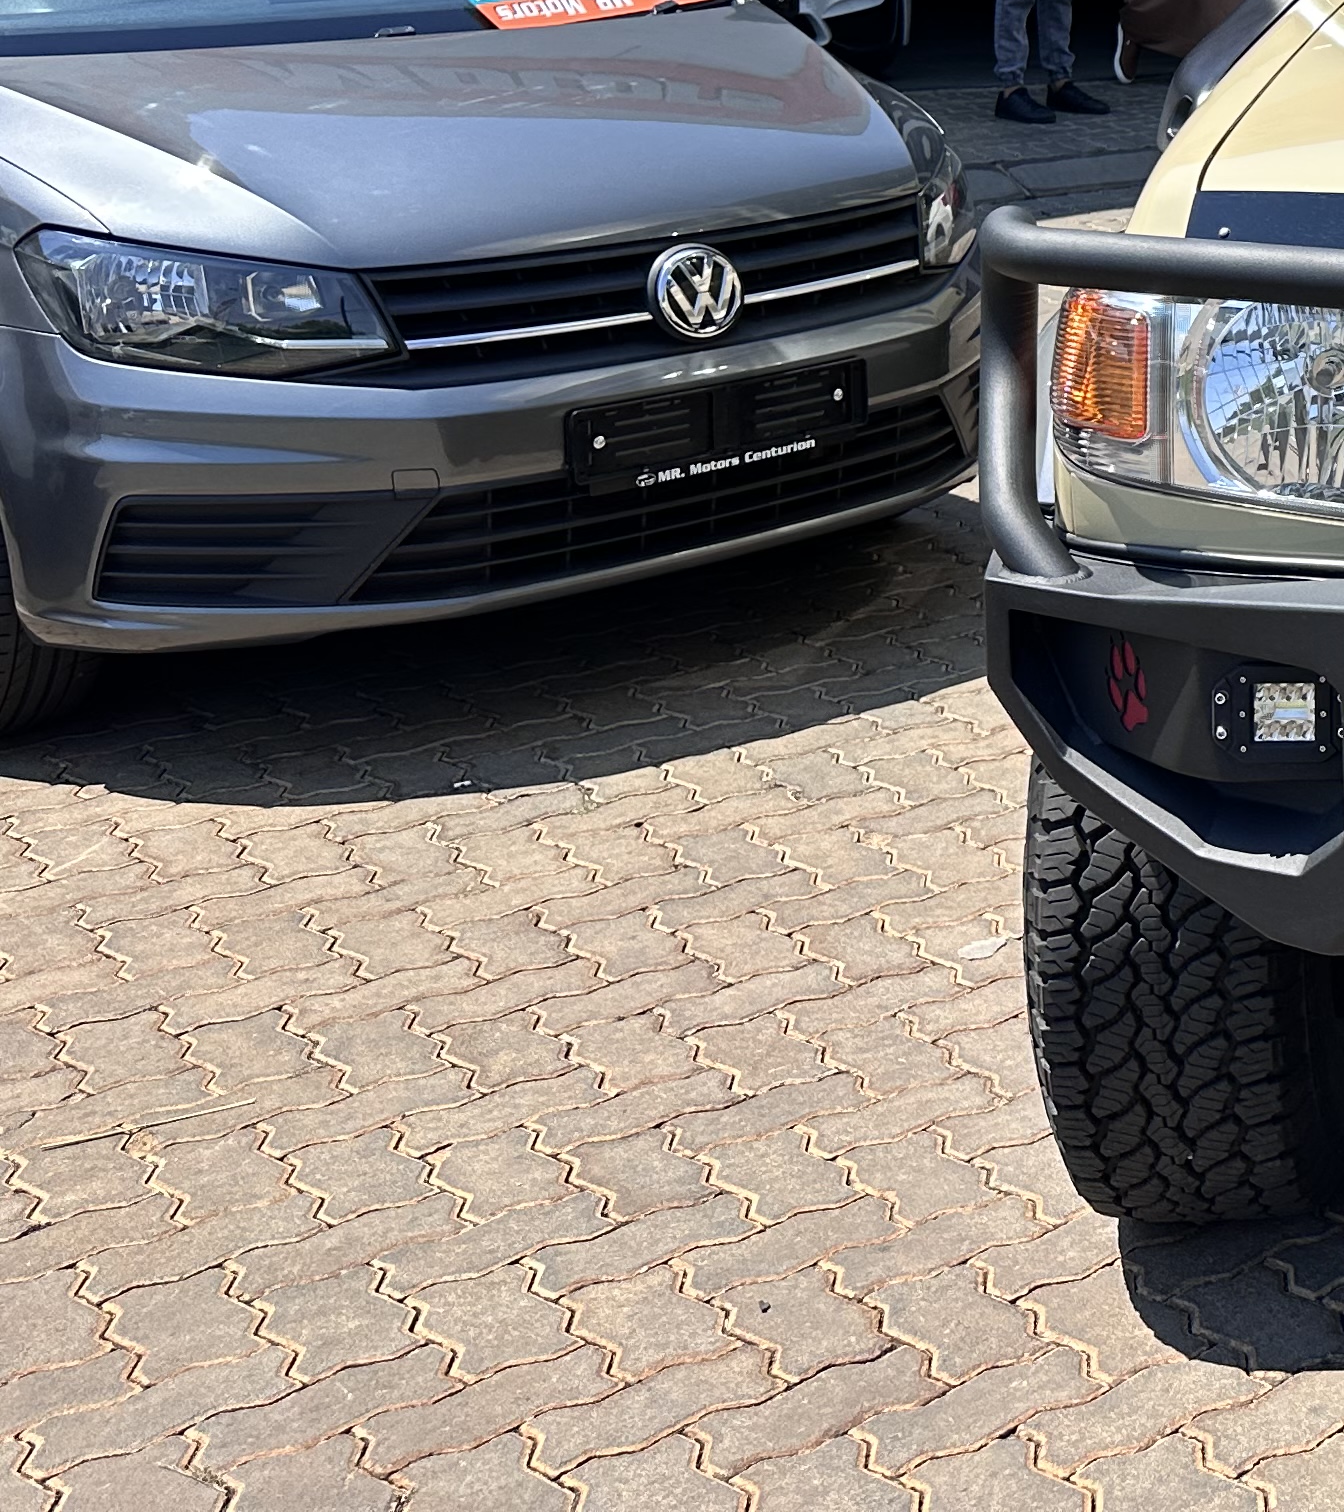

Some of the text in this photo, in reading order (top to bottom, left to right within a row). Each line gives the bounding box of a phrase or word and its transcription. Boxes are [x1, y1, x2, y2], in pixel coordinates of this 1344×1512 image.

[658, 438, 816, 483] MR. Motors Centurion
